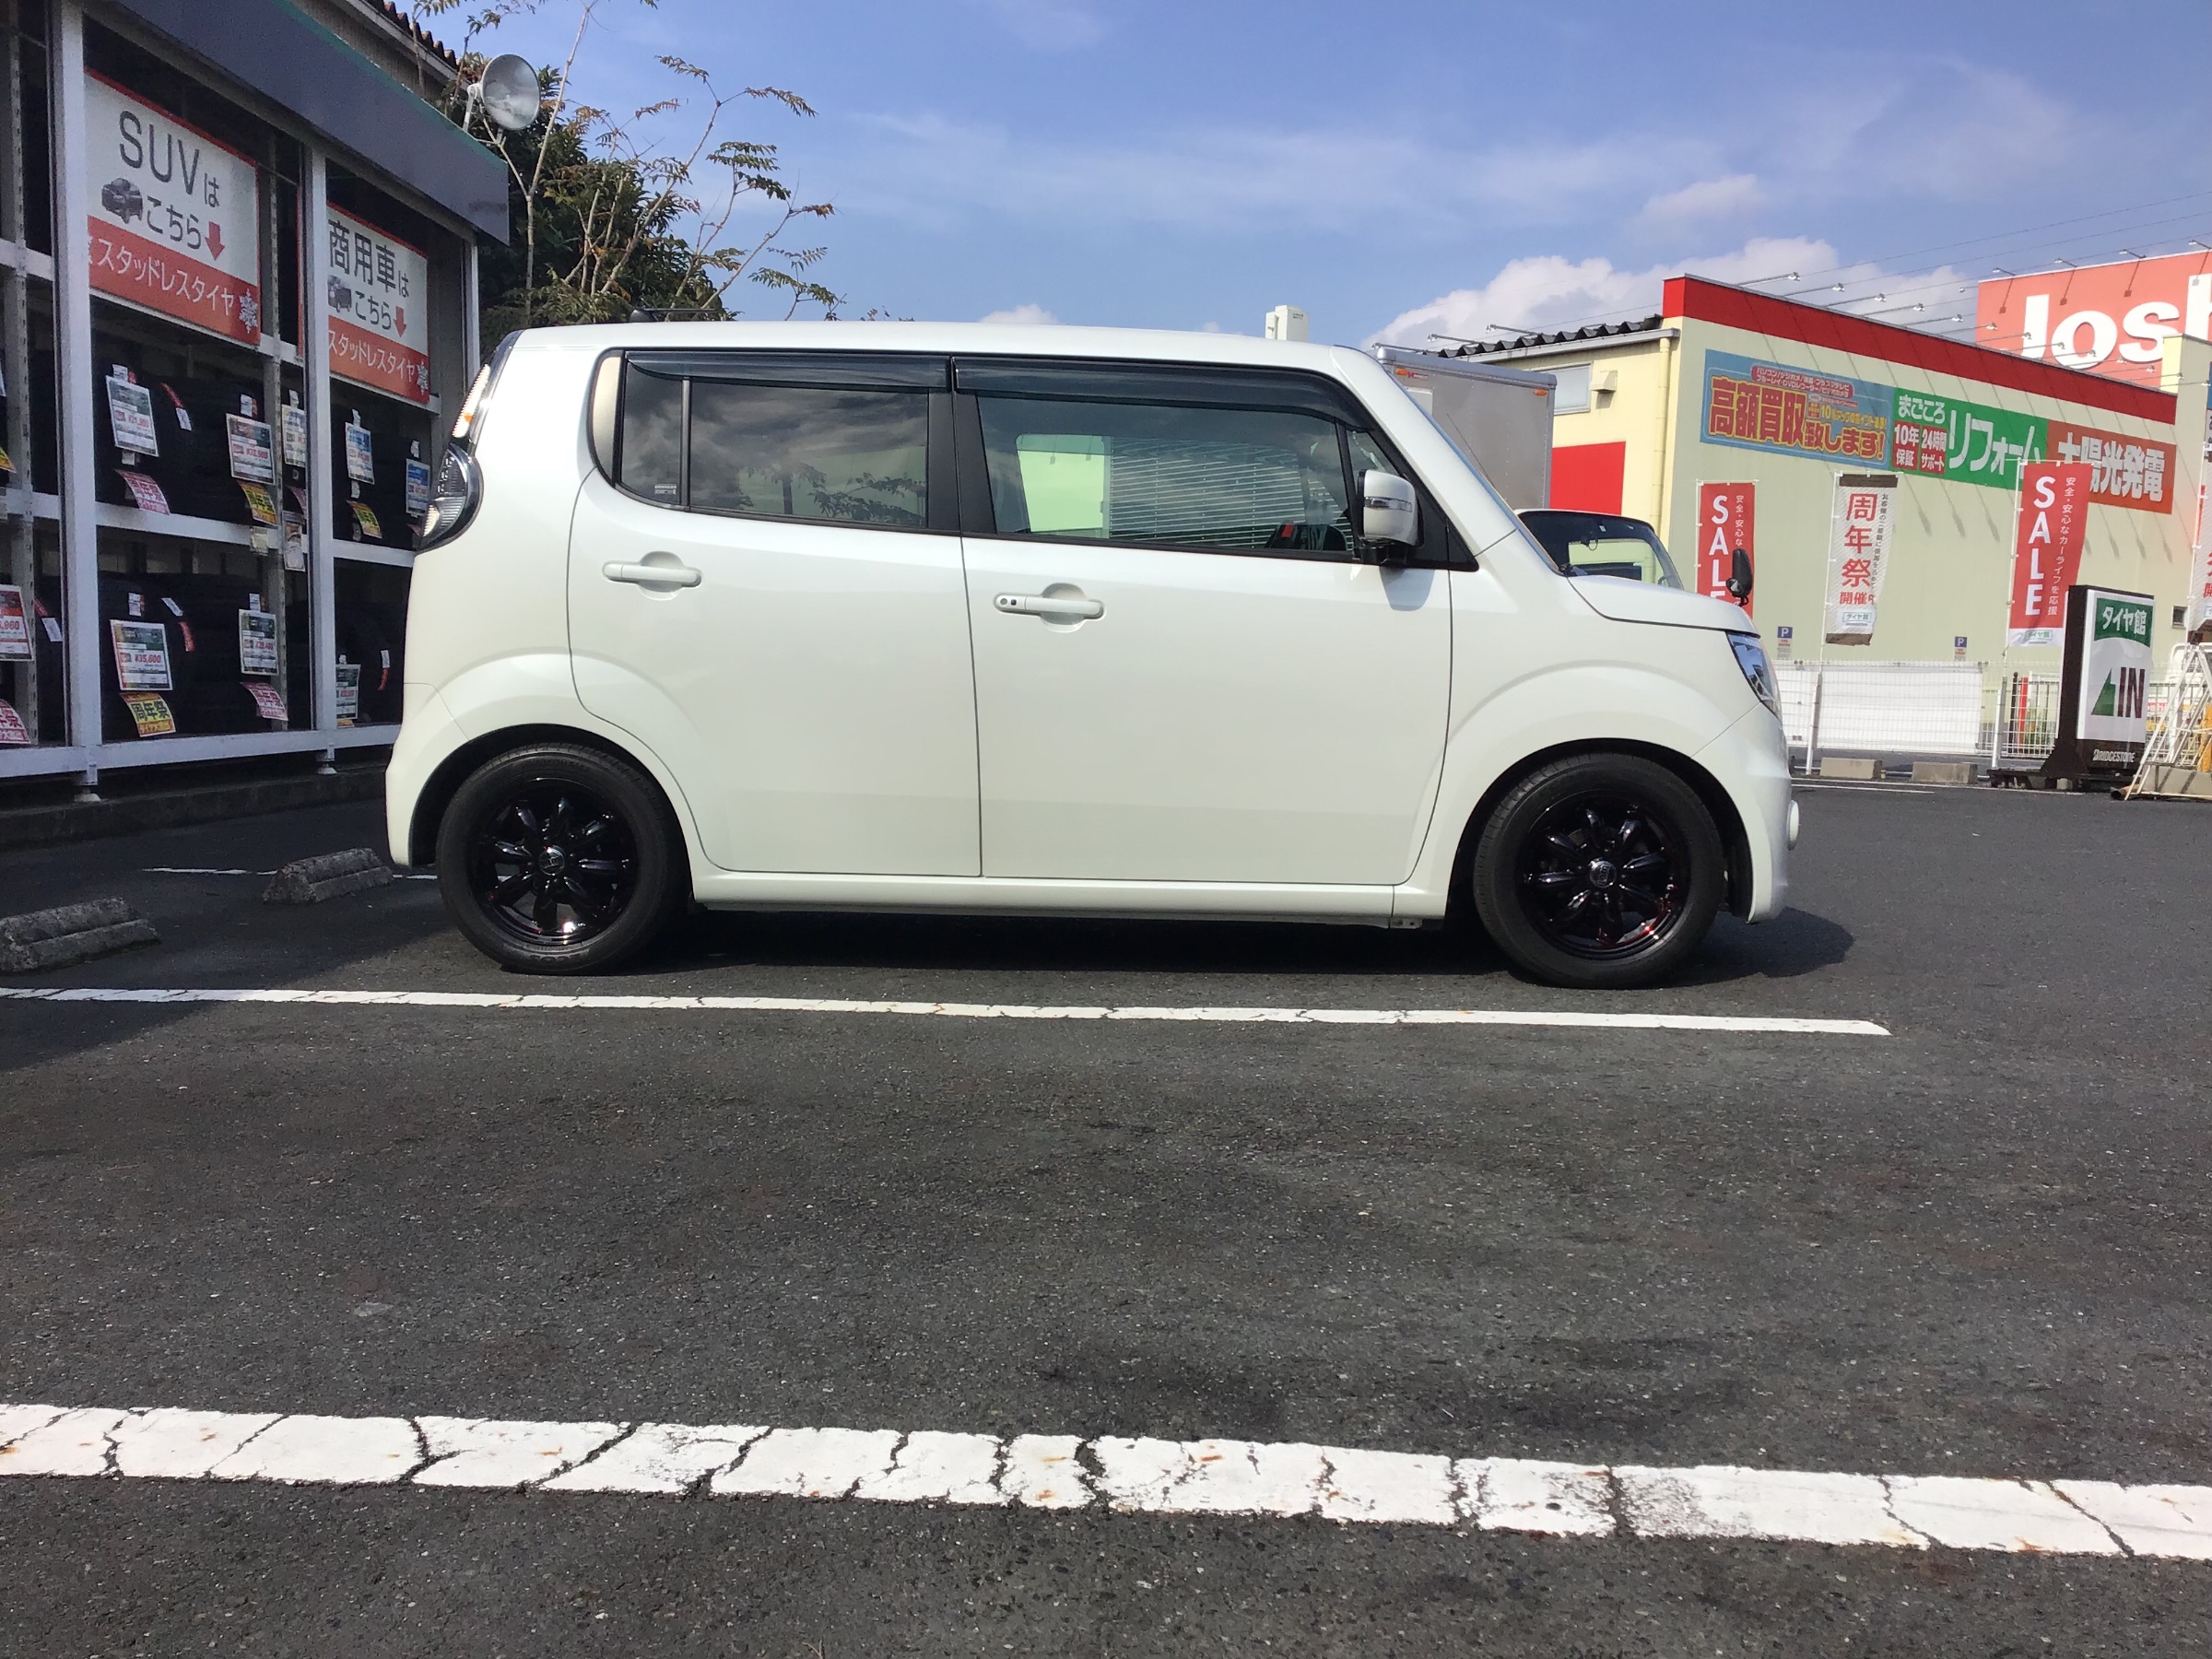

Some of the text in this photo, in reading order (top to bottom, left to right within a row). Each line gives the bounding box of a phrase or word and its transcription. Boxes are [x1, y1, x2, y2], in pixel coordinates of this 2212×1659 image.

[119, 110, 219, 208] SUVは
[147, 194, 202, 250] こちら
[98, 238, 235, 316] スタッドレスタイヤ
[327, 219, 409, 299] 商用車は
[355, 289, 393, 331] こちら
[328, 329, 416, 382] スタッドレスタイヤ
[1899, 394, 1946, 424] まごころ
[1894, 424, 1920, 447] 10年
[1895, 448, 1914, 468] 保証
[1922, 429, 1947, 452] 24時間
[1921, 453, 1945, 473] サポート
[1841, 493, 1878, 588] 周年祭
[2025, 476, 2056, 616] SALE
[2047, 477, 2077, 616] 安全・安心なカーライフを応援
[1781, 627, 1789, 638] P
[2102, 606, 2147, 636] タイヤ館
[2117, 666, 2146, 719] IN
[2092, 748, 2136, 763] BRIDGESTONE
